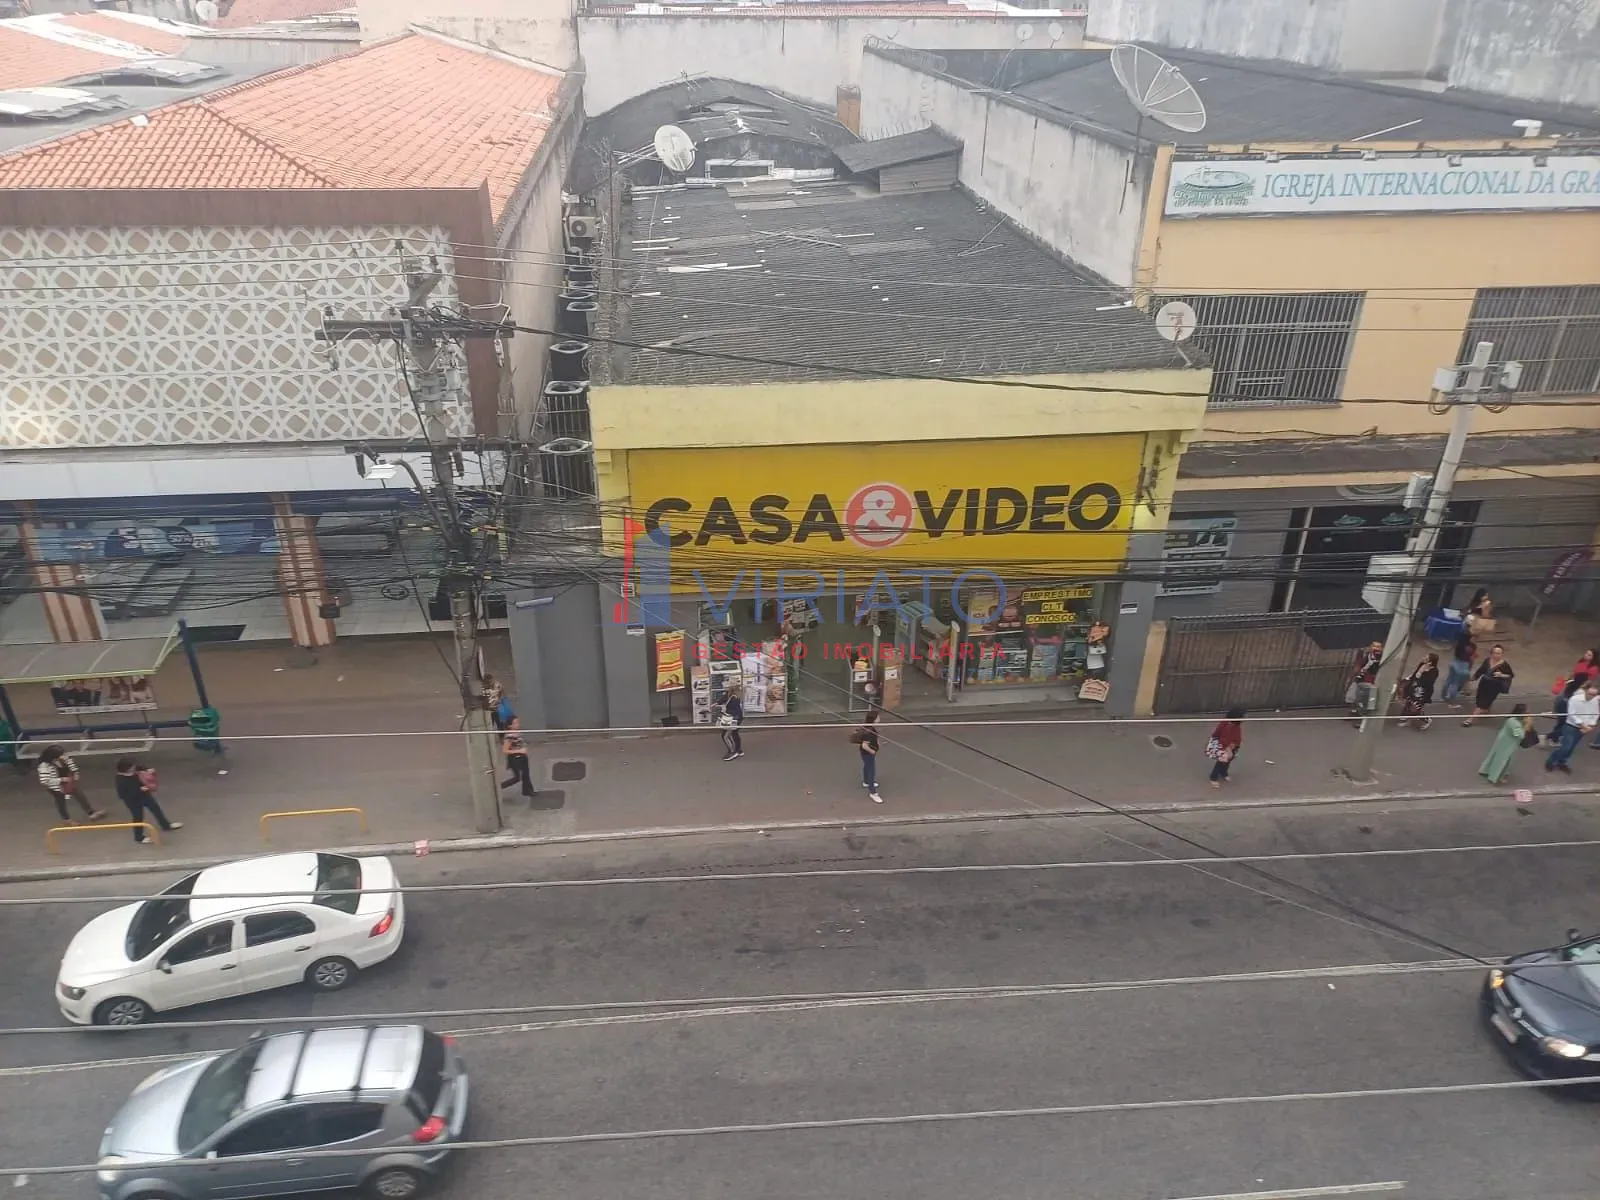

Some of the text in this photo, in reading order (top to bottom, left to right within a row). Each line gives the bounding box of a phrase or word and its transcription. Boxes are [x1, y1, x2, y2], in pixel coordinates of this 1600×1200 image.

[1261, 173, 1336, 205] IGREJA
[1338, 170, 1522, 197] INTERNACIONAL
[1524, 169, 1556, 195] DA
[644, 493, 846, 547] CASA
[912, 482, 1121, 538] VIDEO
[1043, 602, 1063, 611] CLT
